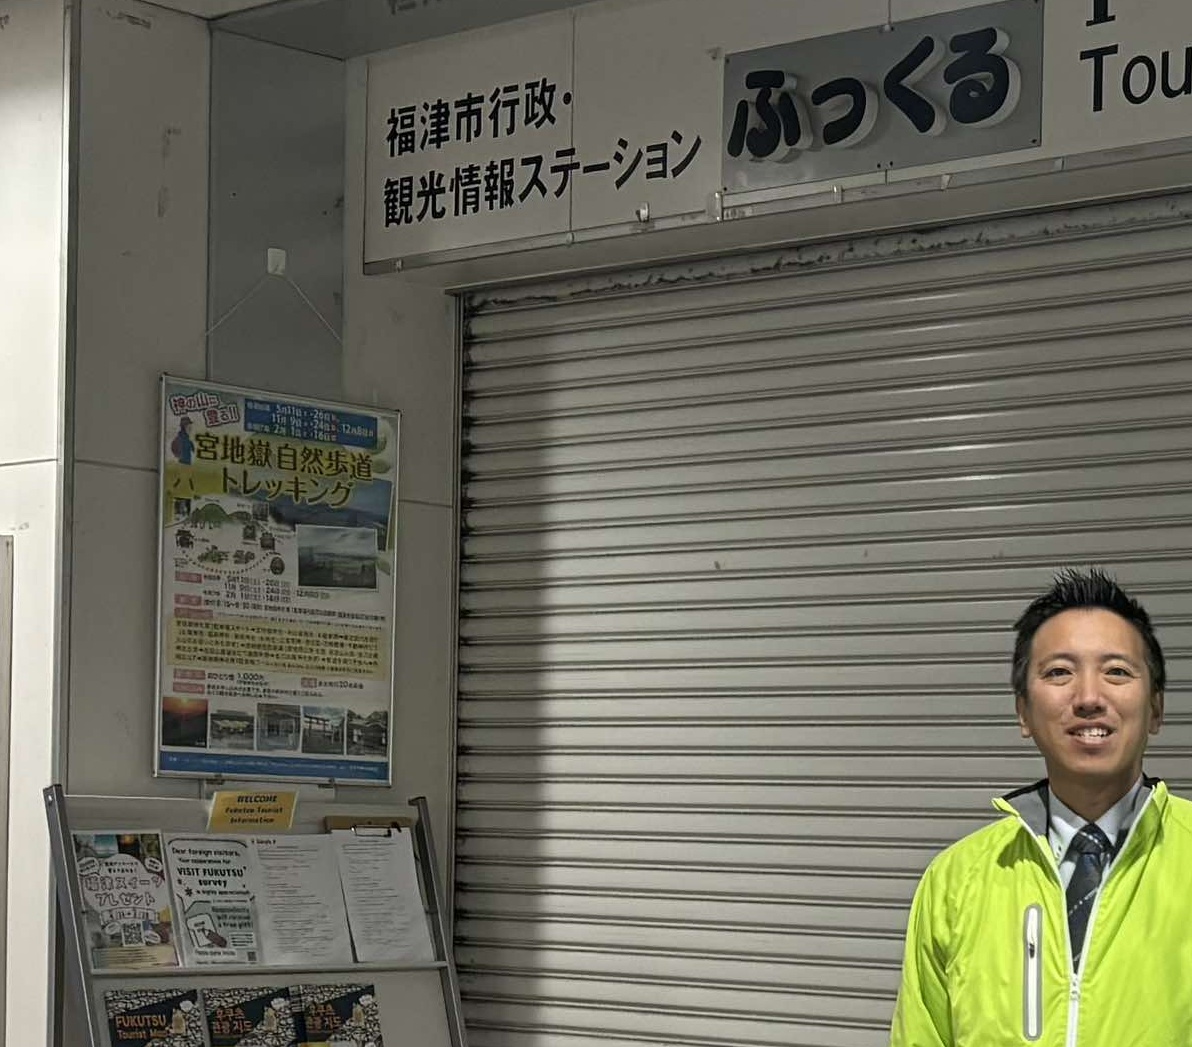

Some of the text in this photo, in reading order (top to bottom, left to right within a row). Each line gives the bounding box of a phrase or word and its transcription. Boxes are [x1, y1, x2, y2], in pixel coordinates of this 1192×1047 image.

[727, 27, 1018, 161] ふっくる
[383, 129, 701, 228] 観光情報ステーション
[195, 432, 374, 482] 宮地嶽自然歩道
[222, 467, 352, 506] トレッキング
[176, 867, 244, 877] VISIT FUKUTSU
[198, 879, 227, 888] survey
[115, 1014, 167, 1027] FUKUTSU
